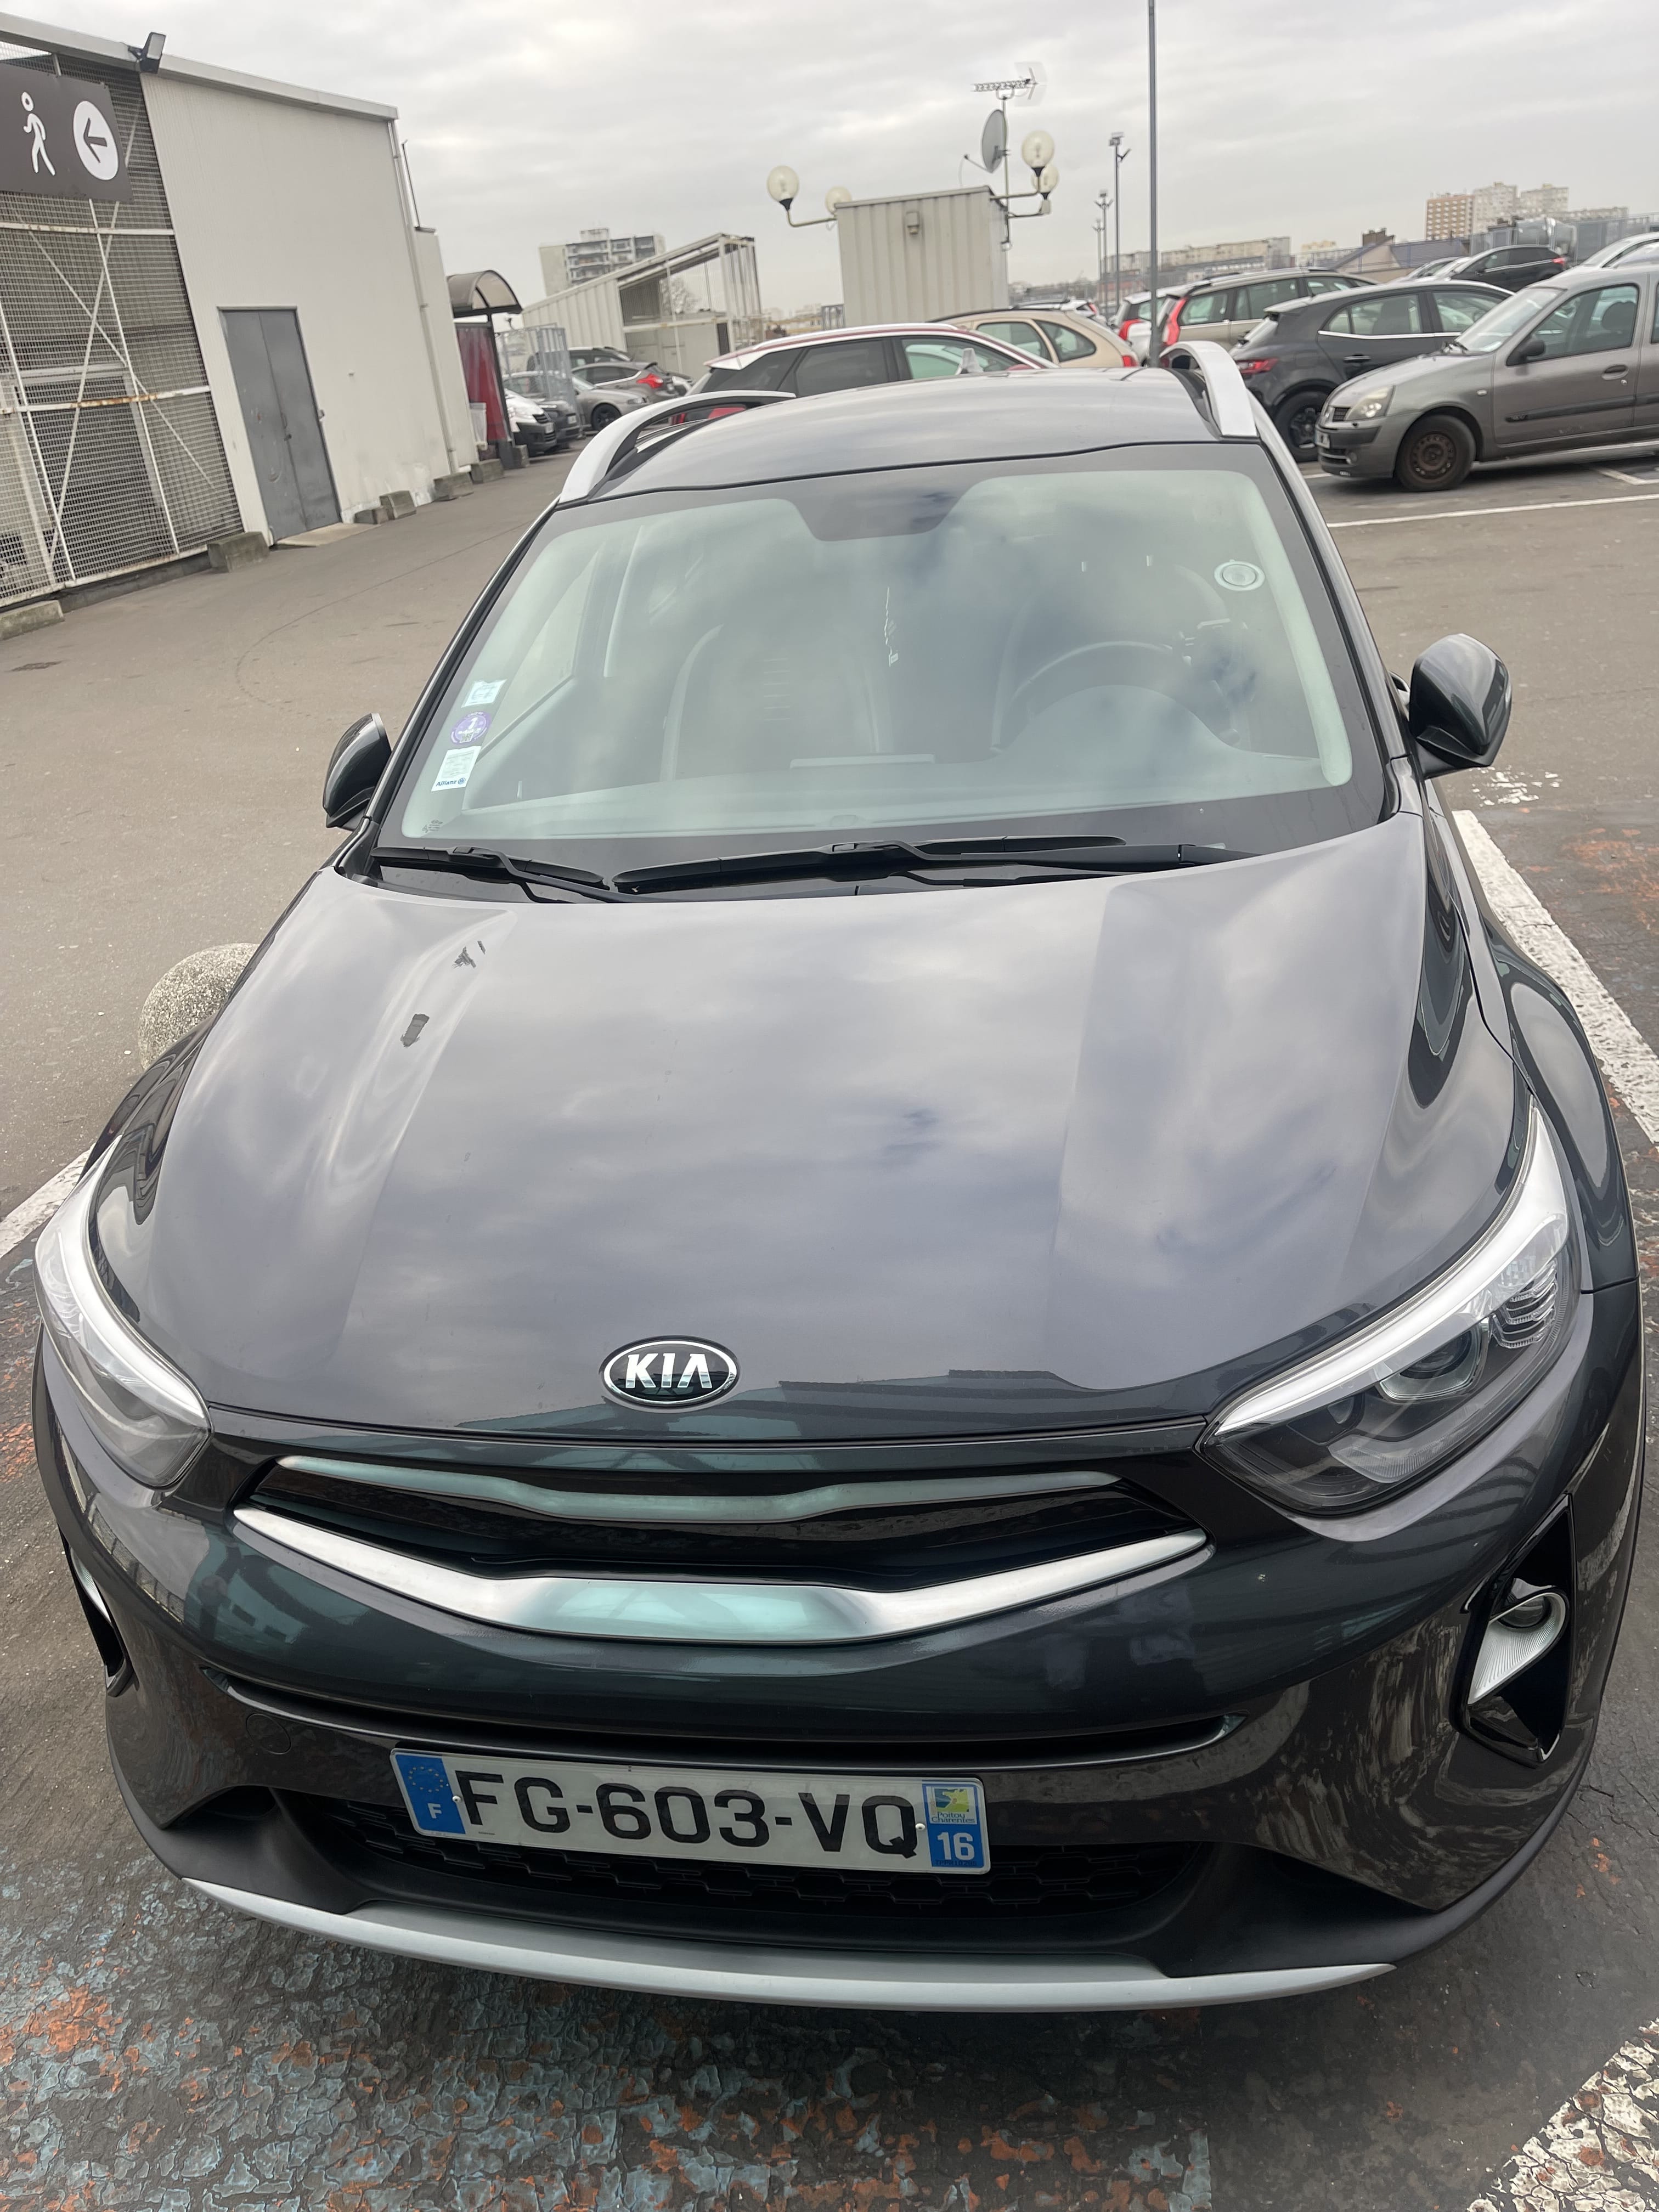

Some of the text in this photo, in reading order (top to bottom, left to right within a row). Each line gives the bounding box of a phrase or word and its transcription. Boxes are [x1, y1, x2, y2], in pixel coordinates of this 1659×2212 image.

[625, 1353, 713, 1388] KIA
[427, 1803, 442, 1819] F
[455, 1770, 918, 1859] FG-603-VQ
[937, 1831, 975, 1861] 16
